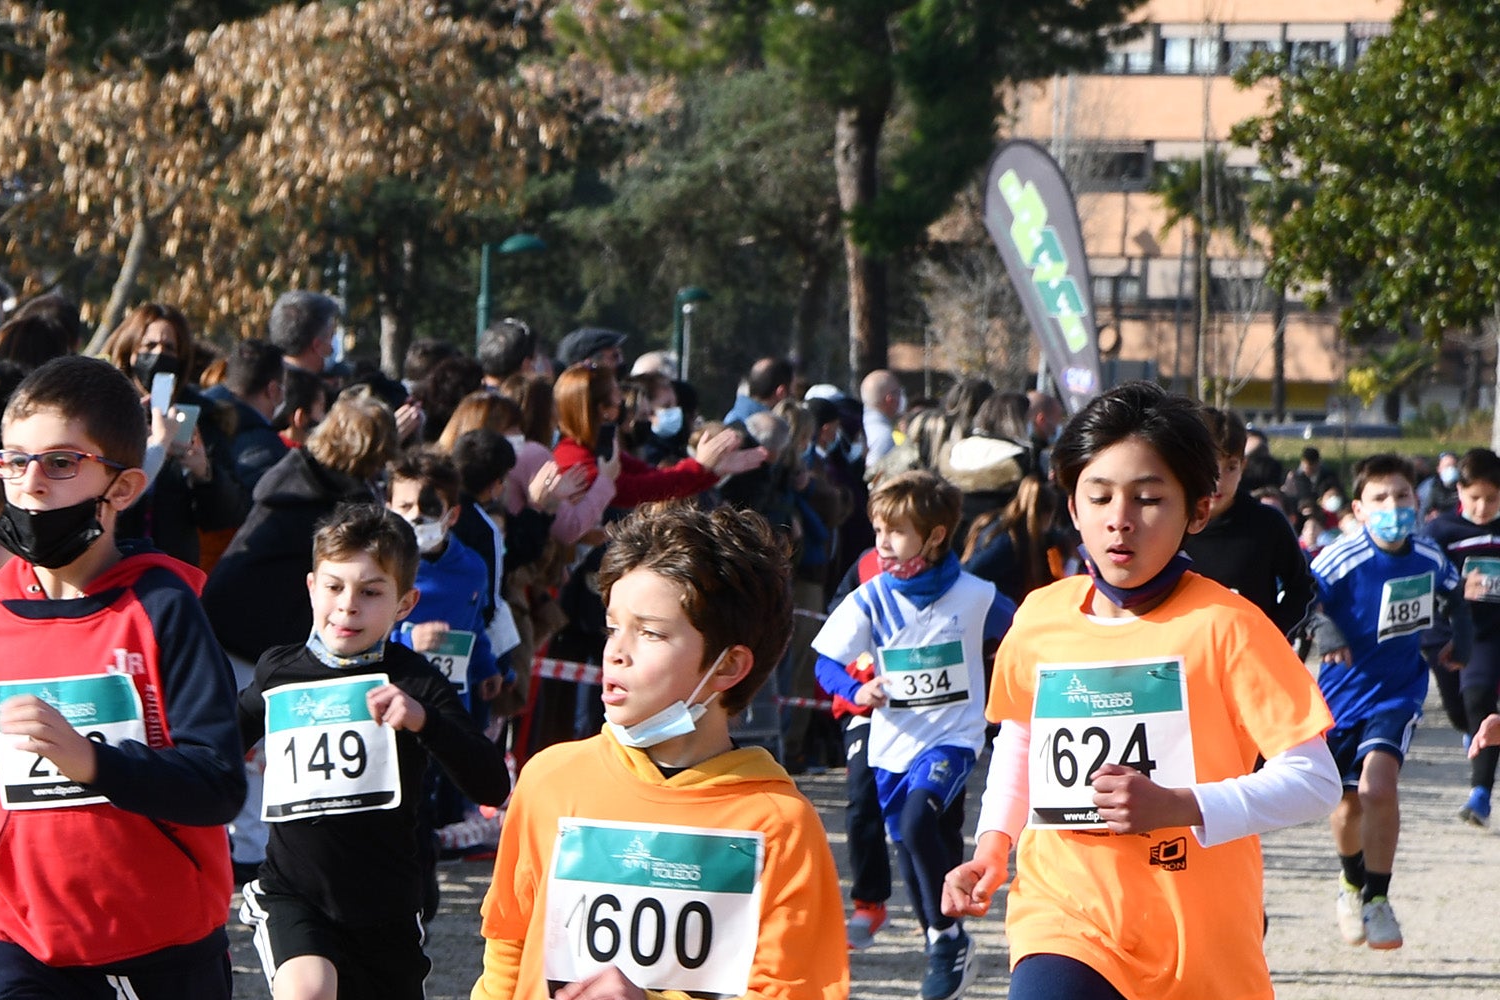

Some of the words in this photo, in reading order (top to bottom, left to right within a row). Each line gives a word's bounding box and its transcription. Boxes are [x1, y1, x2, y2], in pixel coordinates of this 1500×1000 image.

[1386, 600, 1421, 623] 489
[903, 669, 952, 696] 334
[1091, 697, 1134, 709] TOLEDO
[284, 729, 368, 785] 149
[652, 867, 702, 881] TOLEDO
